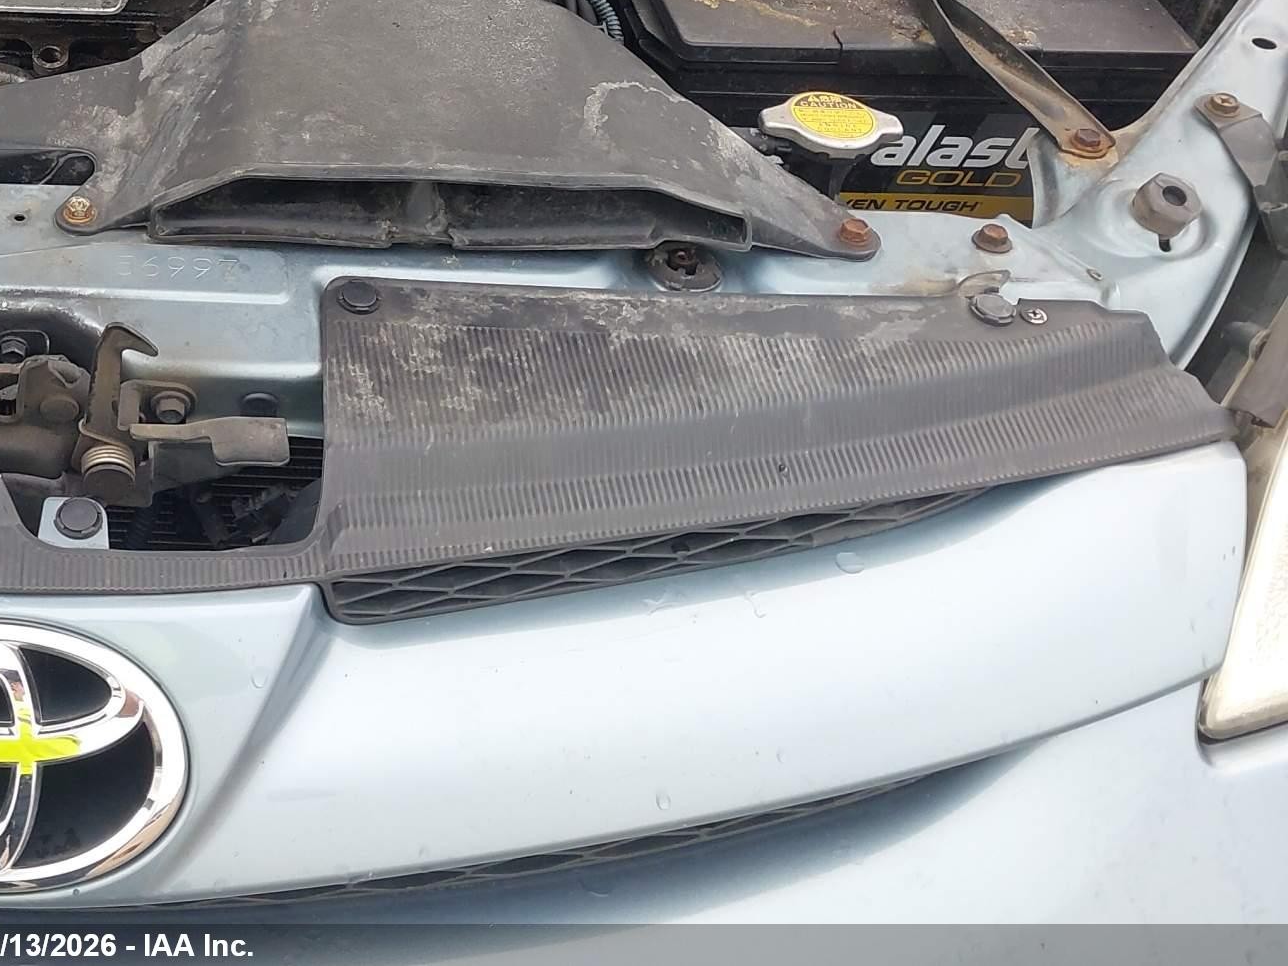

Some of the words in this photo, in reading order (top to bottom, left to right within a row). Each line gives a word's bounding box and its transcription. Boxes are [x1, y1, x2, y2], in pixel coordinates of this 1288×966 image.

[800, 101, 857, 109] CAUTION
[896, 169, 1022, 187] GOLD
[895, 199, 979, 212] TOUGH
